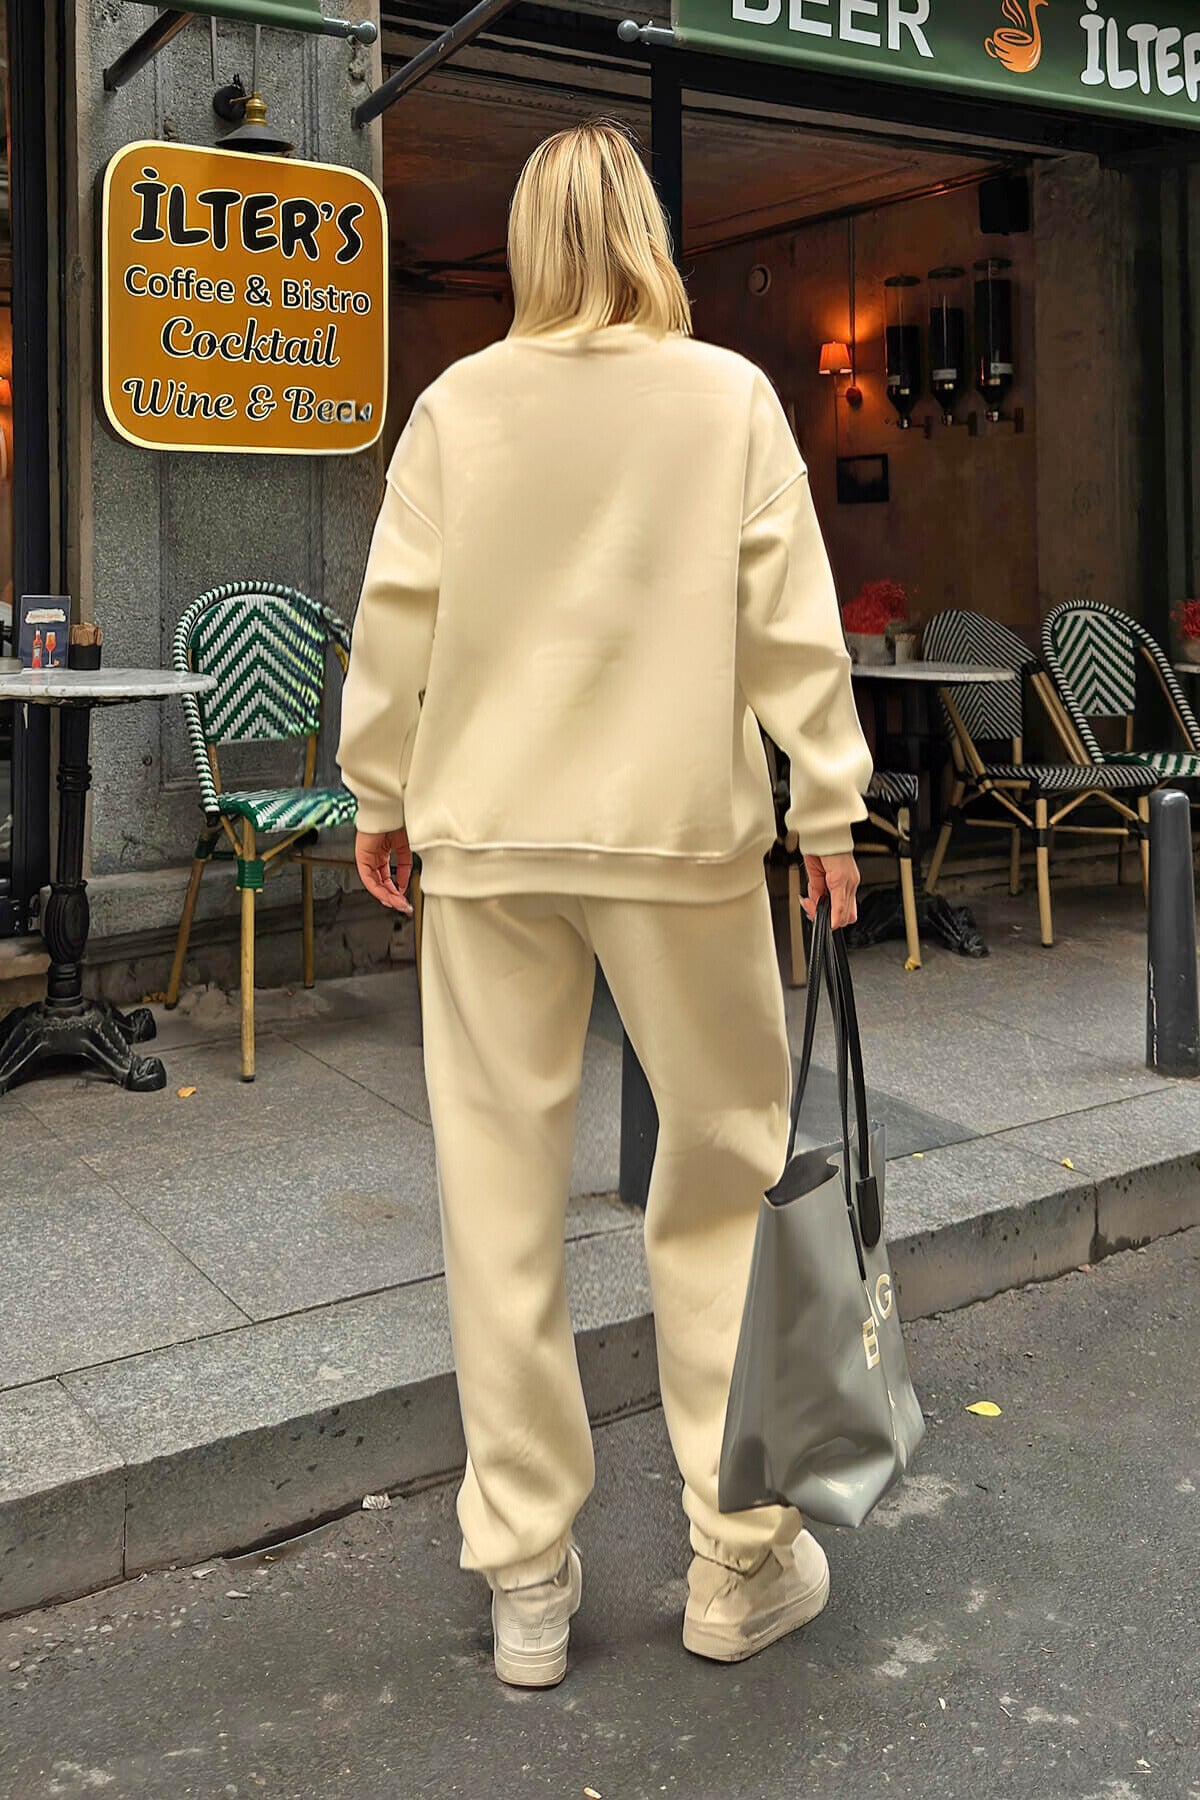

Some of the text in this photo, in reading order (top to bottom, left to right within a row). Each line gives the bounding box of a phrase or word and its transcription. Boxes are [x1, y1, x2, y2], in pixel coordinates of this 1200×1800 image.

[131, 166, 365, 264] İLTER'S
[124, 265, 372, 315] Coffee & Bistro
[161, 316, 341, 368] Cocktail
[122, 377, 237, 419] Wine
[246, 385, 276, 421] &
